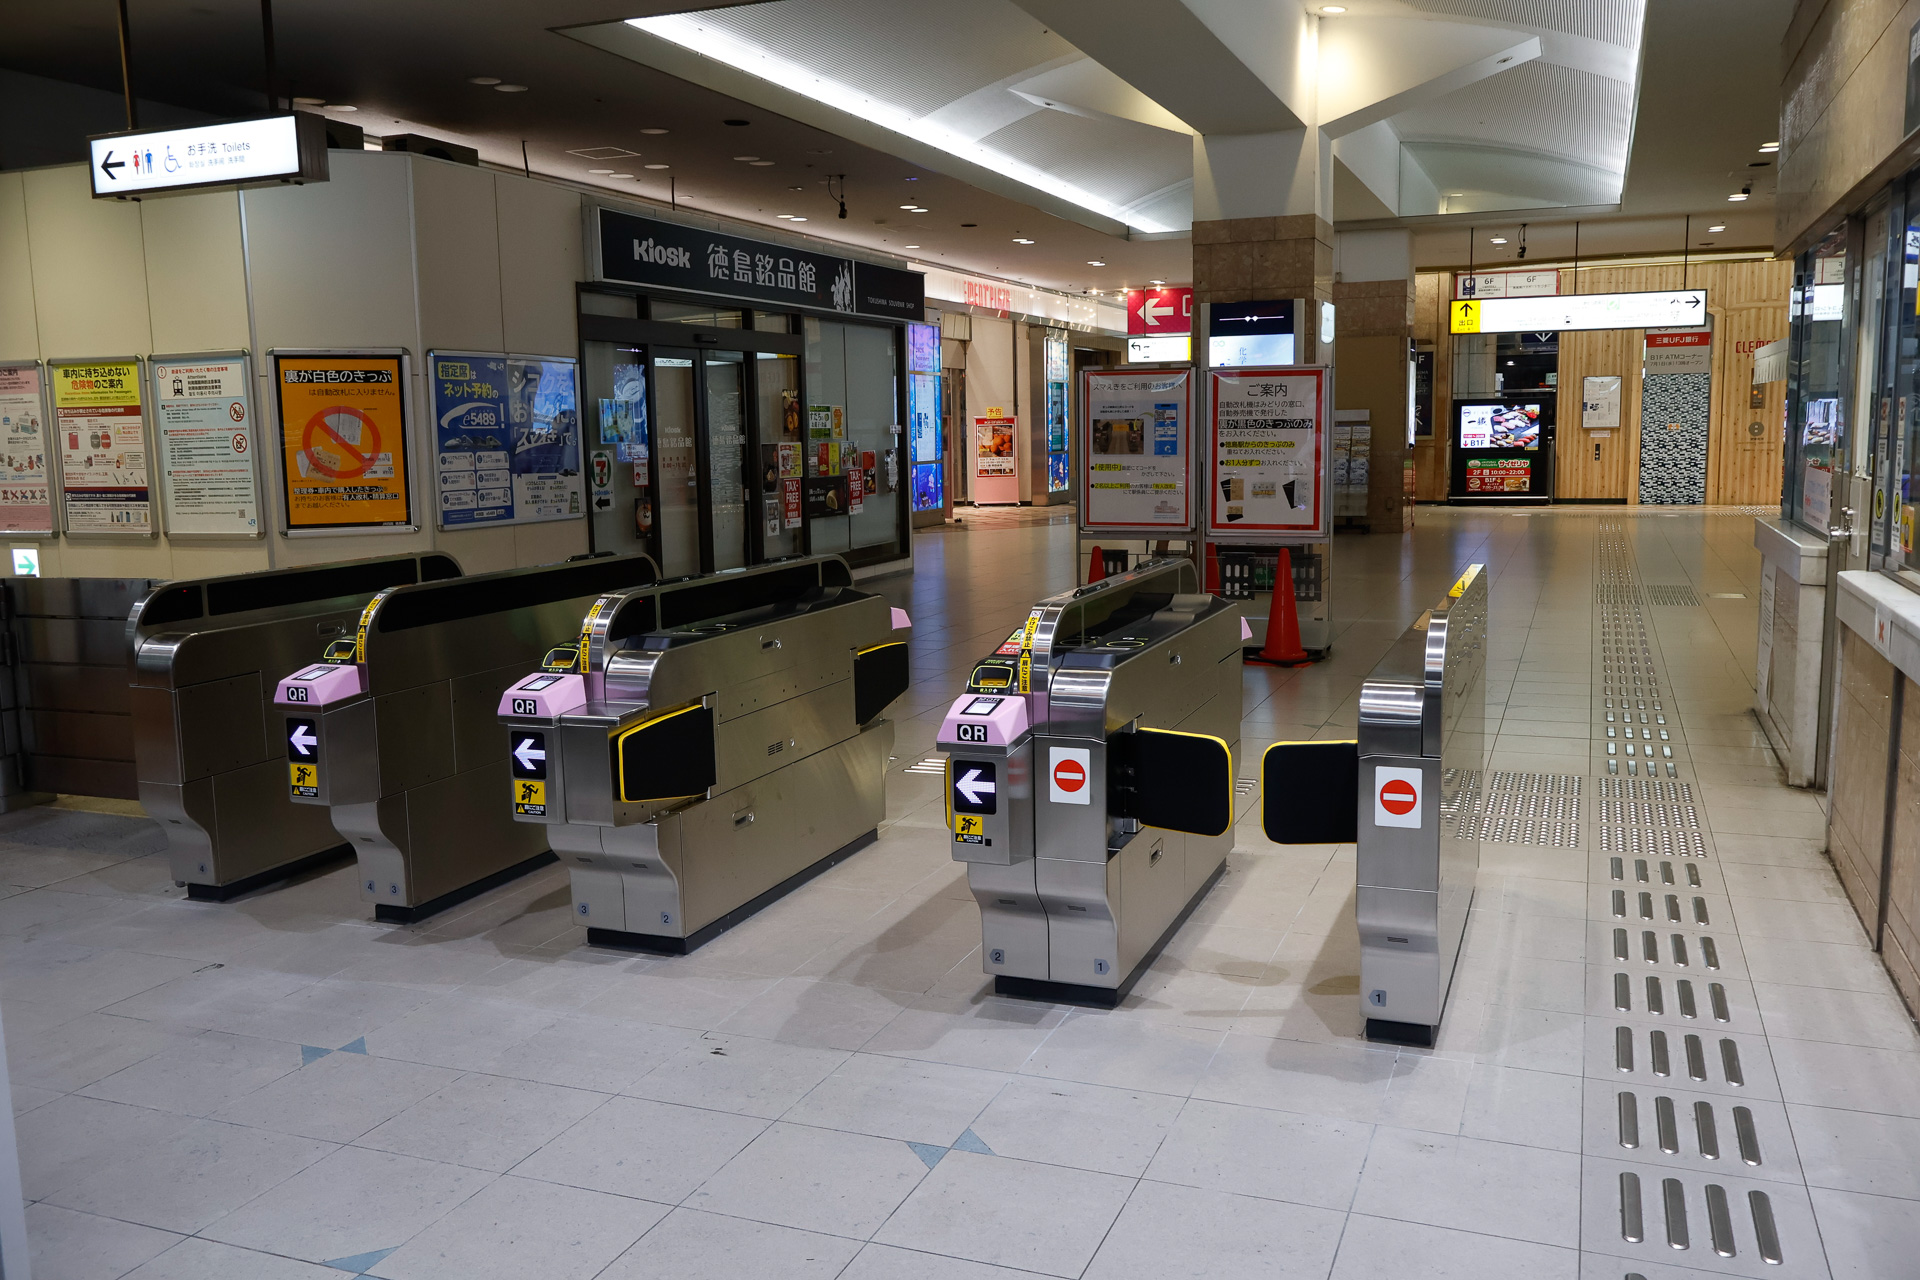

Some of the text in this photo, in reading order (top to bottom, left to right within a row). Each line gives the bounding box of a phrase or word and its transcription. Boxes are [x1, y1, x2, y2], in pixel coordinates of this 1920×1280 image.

[188, 142, 250, 156] お手洗 Toilets
[633, 238, 816, 292] Kiosk 徳島銘品館
[1656, 336, 1698, 344] 三菱UFJ銀行
[63, 368, 130, 379] 車内に持ち込めない
[285, 370, 392, 383] 裏が白色のきっぷ
[440, 364, 477, 380] 指定席は
[71, 380, 124, 390] 危険物のご案内
[444, 382, 498, 398] ネット予約の
[1094, 382, 1183, 391] スマえきをご利用のお客様へ
[1247, 383, 1288, 397] ご案内
[309, 388, 396, 396] は自動改札に入りません。
[1220, 400, 1305, 409] 自動改札機はみどりの窓口、
[988, 408, 1002, 416] 予告
[462, 412, 496, 426] e5489
[1219, 419, 1312, 429] 裏が黒色のきっぷのみ
[1498, 460, 1529, 468] サイゼリヤ
[850, 481, 861, 491] FREE
[786, 492, 799, 503] FREE
[288, 688, 307, 701] QR
[514, 700, 535, 714] QR
[960, 725, 985, 740] QR
[663, 915, 669, 923] 2
[995, 952, 1001, 961] 2
[1098, 962, 1102, 971] 1
[1376, 994, 1380, 1003] 1
